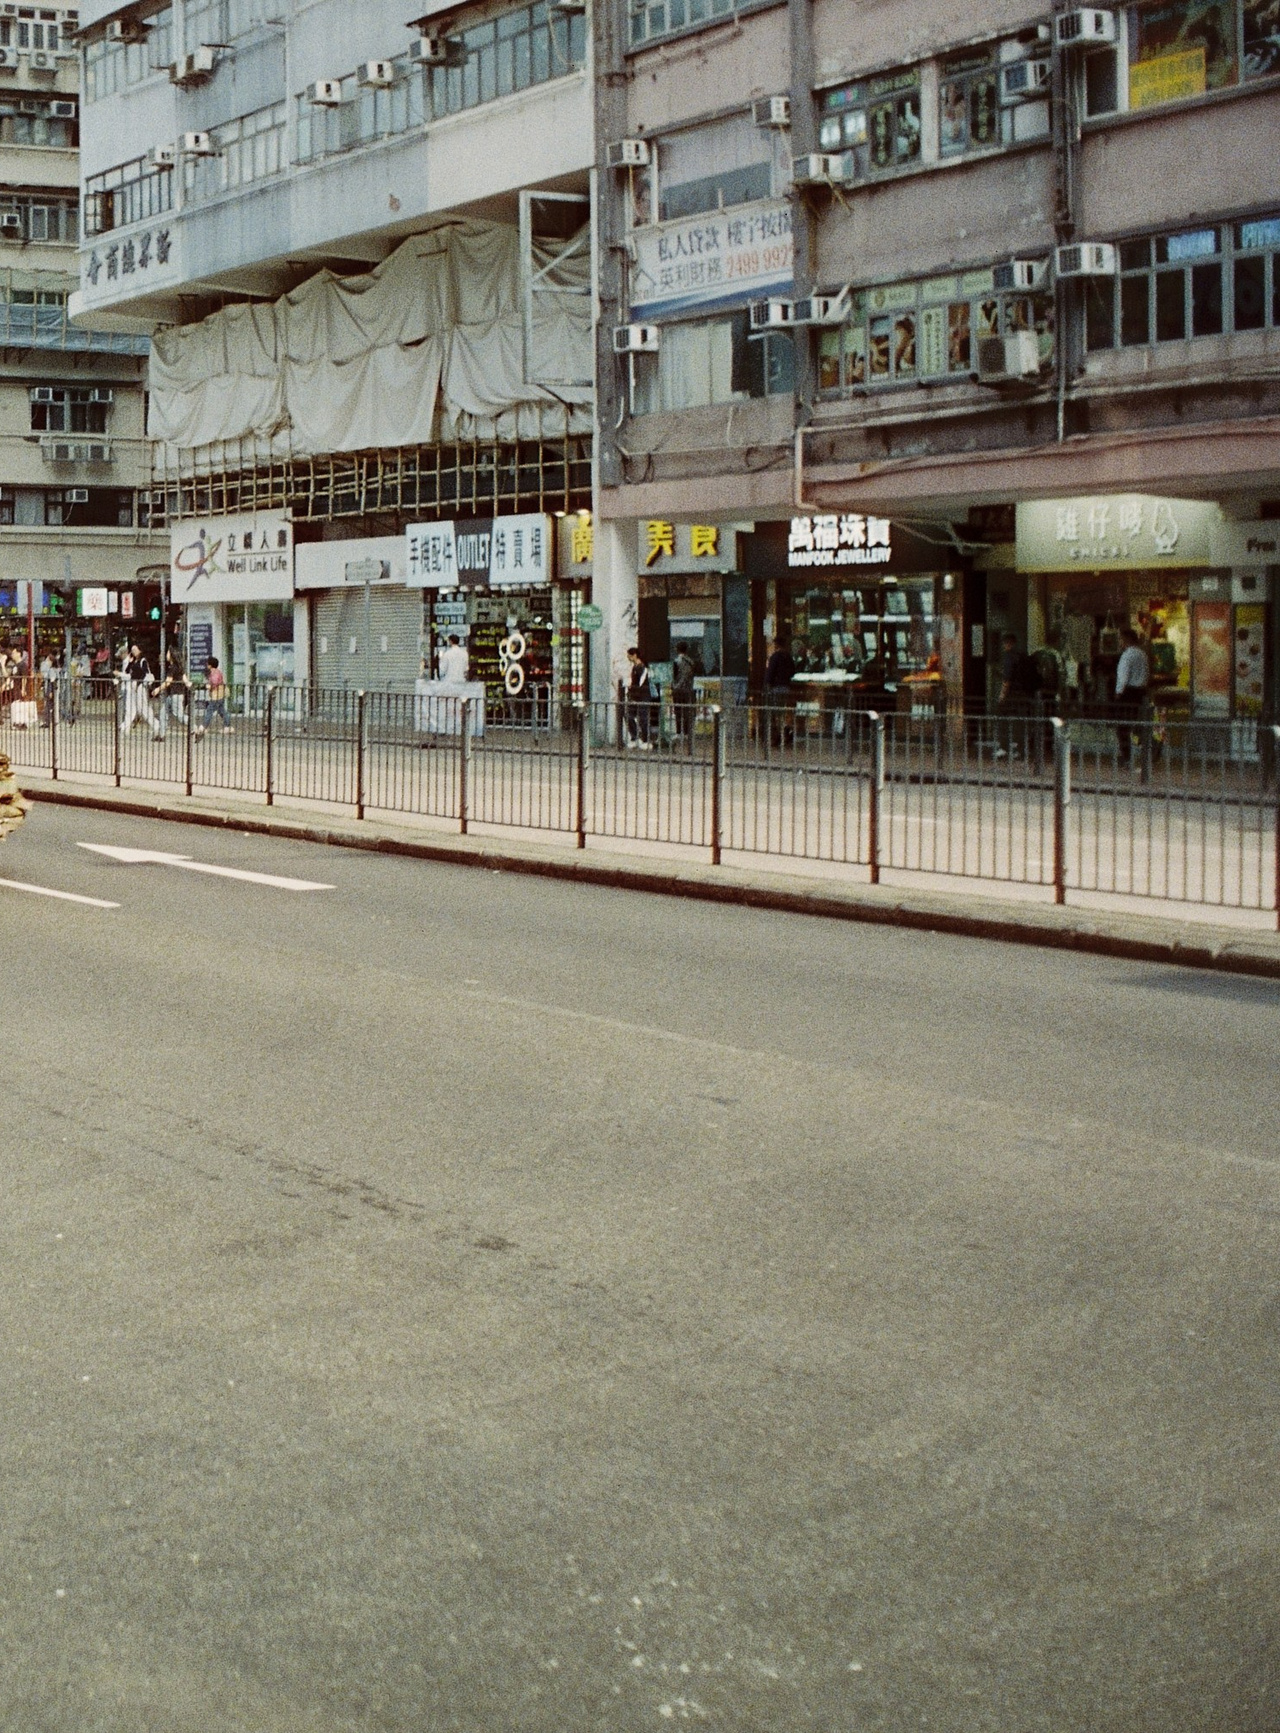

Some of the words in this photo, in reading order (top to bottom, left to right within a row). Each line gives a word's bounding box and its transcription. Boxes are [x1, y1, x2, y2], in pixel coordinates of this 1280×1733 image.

[658, 225, 719, 261] 私人貸款
[726, 250, 759, 279] 2499
[764, 244, 793, 271] 992
[410, 533, 453, 575] 手機配件
[458, 533, 491, 570] OUTLET
[496, 526, 542, 570] 特賣場
[788, 514, 890, 552] 萬福珠寶
[227, 559, 246, 573] Well
[250, 558, 267, 573] Link
[270, 556, 287, 572] Life
[788, 550, 835, 567] MANFOOK
[835, 547, 892, 565] JEWELLERY
